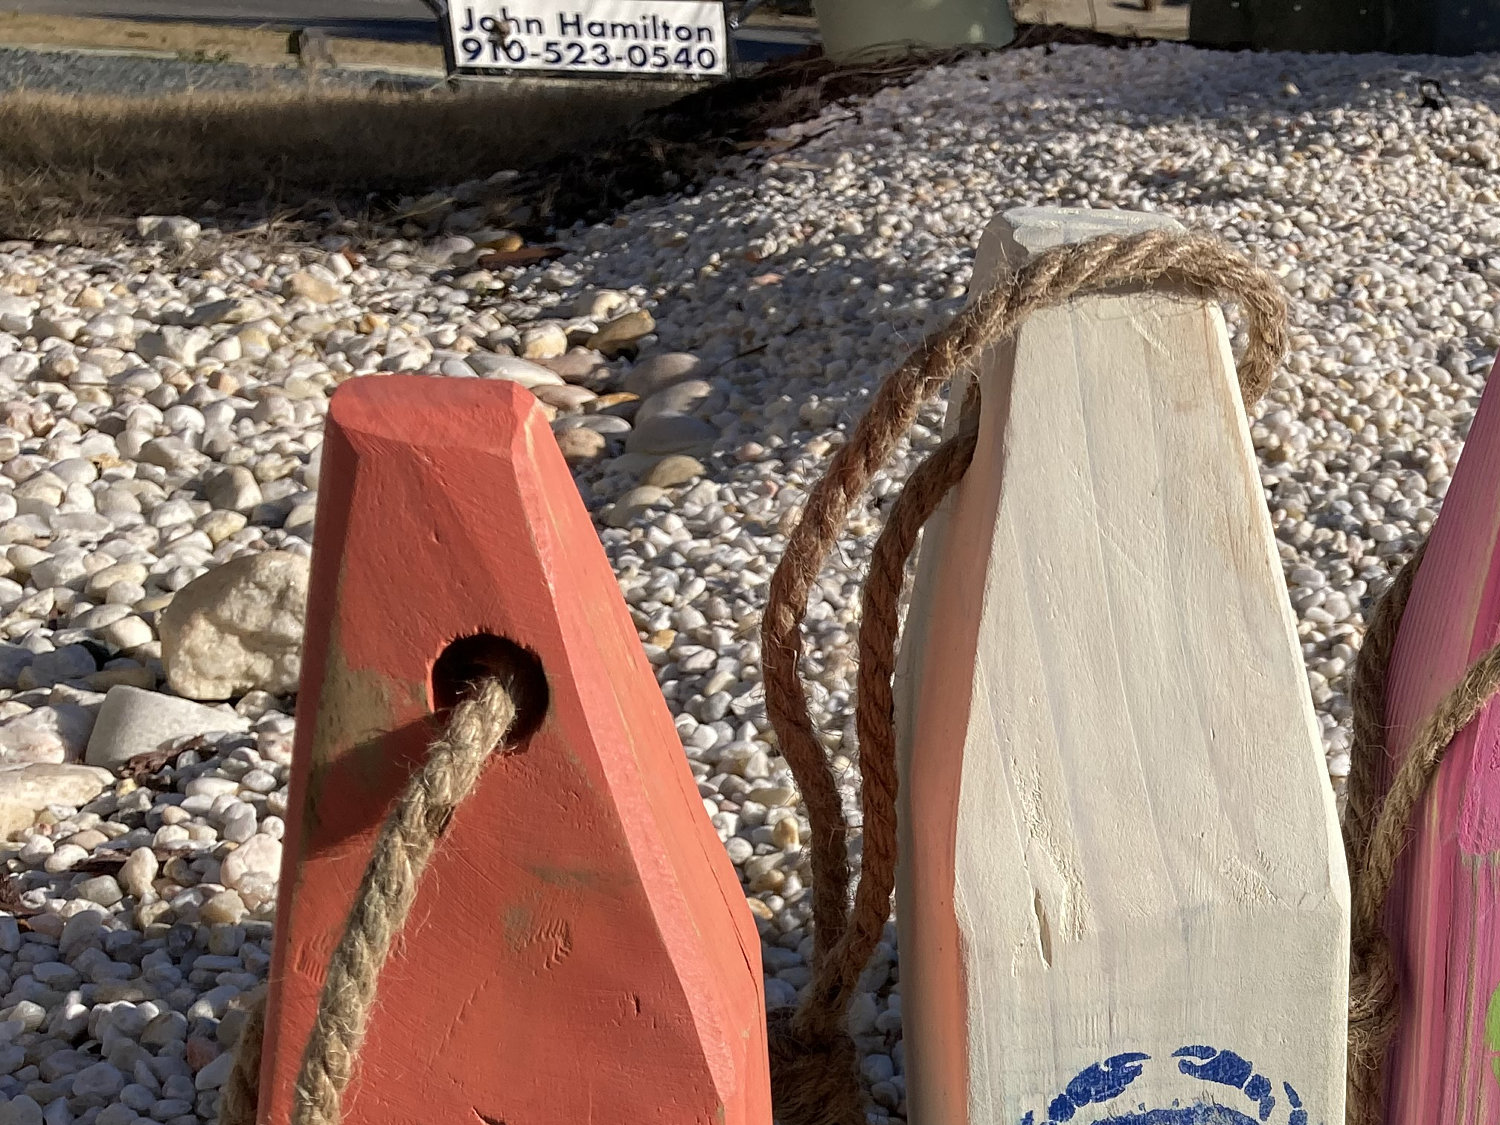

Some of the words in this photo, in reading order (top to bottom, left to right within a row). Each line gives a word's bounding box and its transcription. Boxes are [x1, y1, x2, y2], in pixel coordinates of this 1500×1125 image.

[460, 7, 544, 36] John
[558, 11, 714, 42] Hamilton
[461, 37, 716, 70] 910-523-0540
